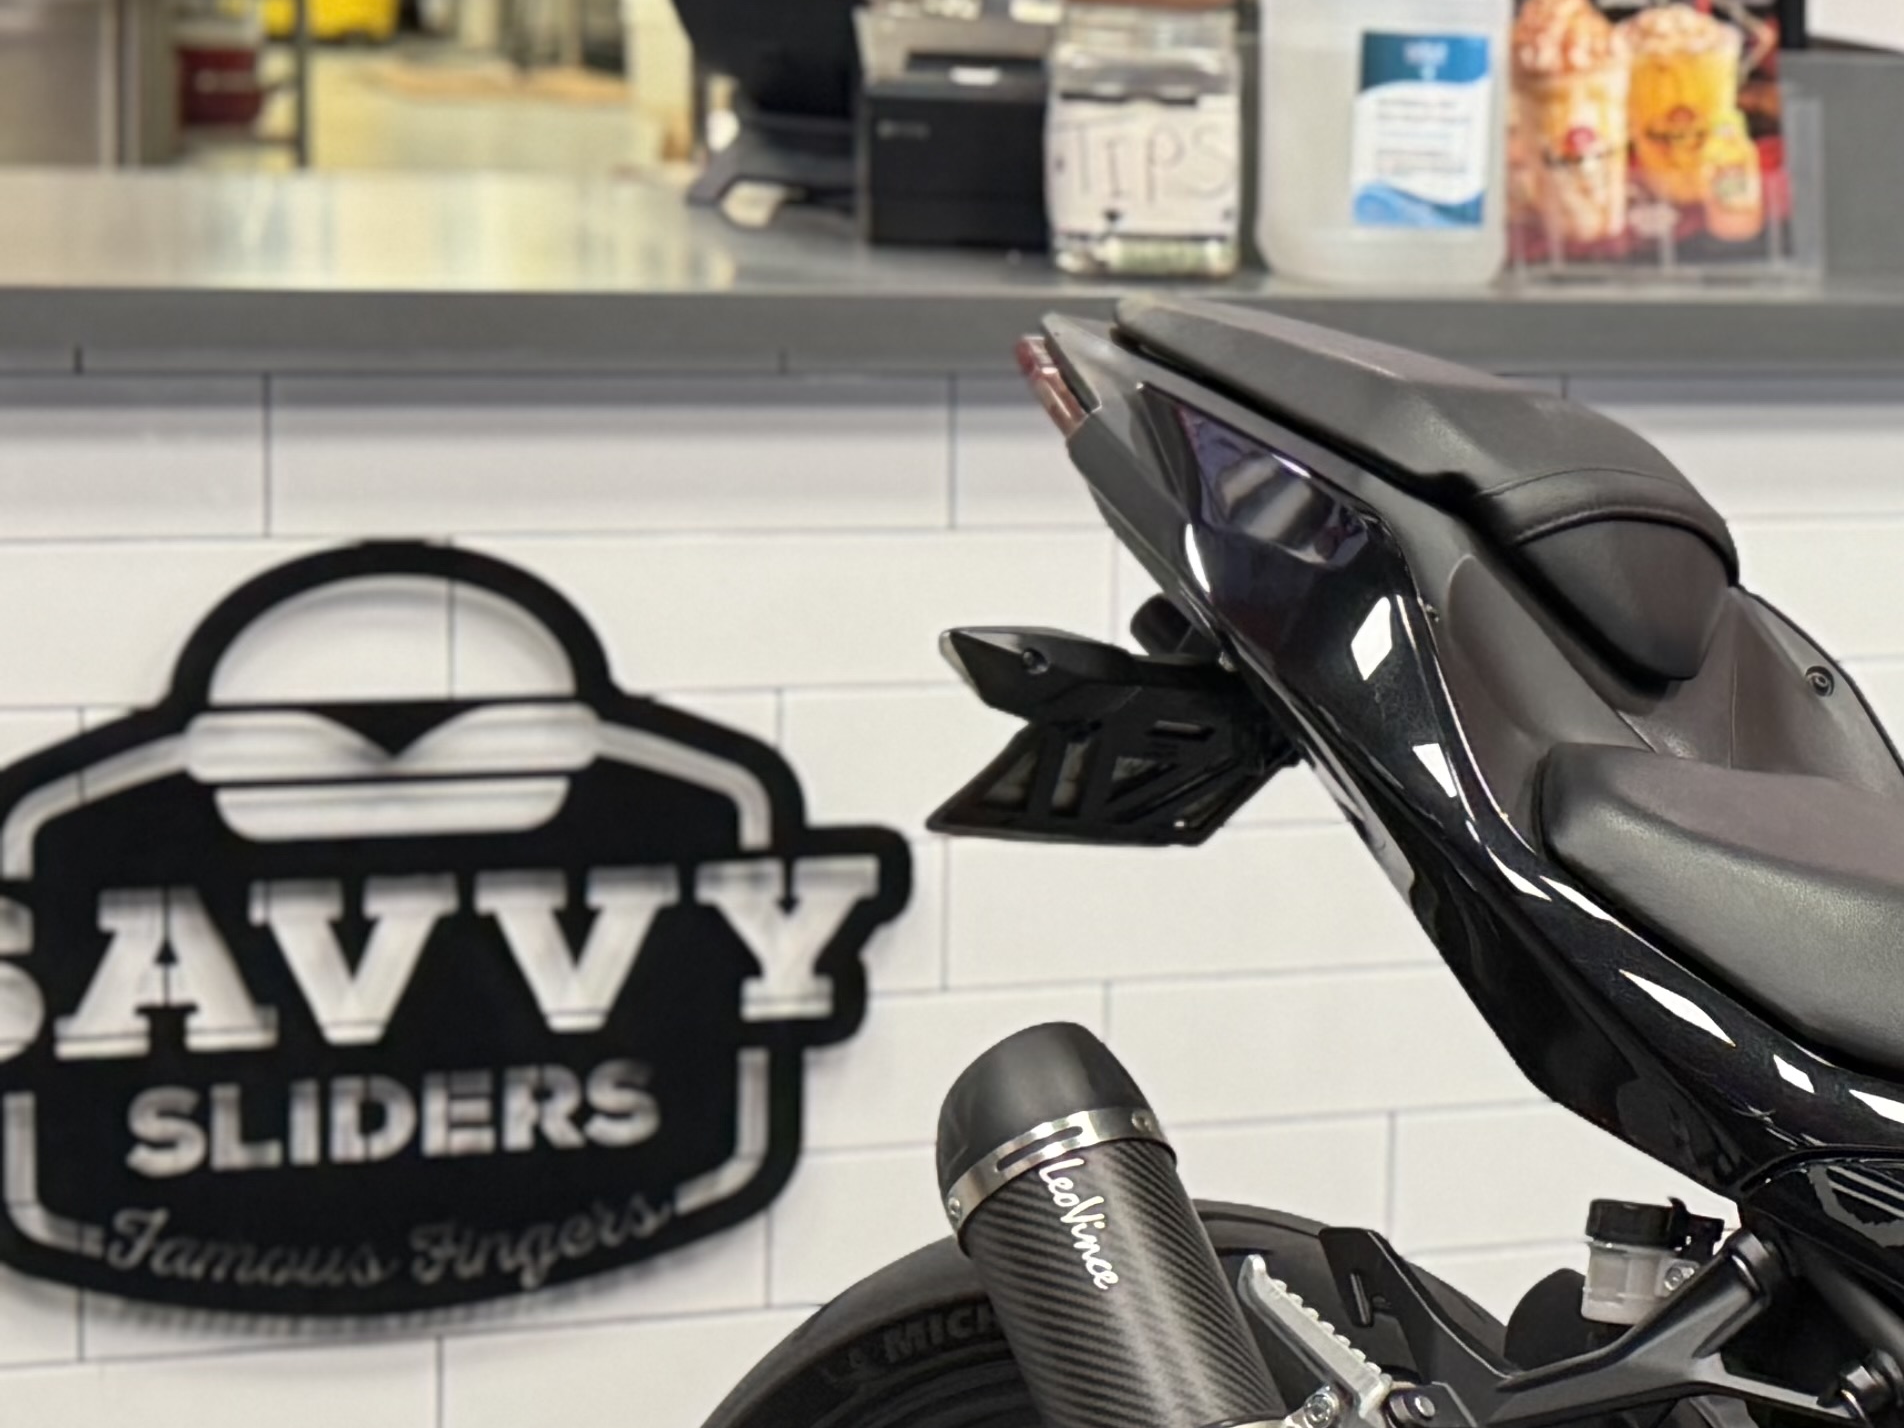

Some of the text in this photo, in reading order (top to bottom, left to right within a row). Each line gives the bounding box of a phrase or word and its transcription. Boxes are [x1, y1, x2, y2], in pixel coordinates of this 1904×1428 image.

[1062, 118, 1232, 204] TIPS
[126, 1059, 663, 1177] SLIDERS
[101, 1188, 676, 1295] Famous Fingers
[1038, 1157, 1119, 1291] LeoVince
